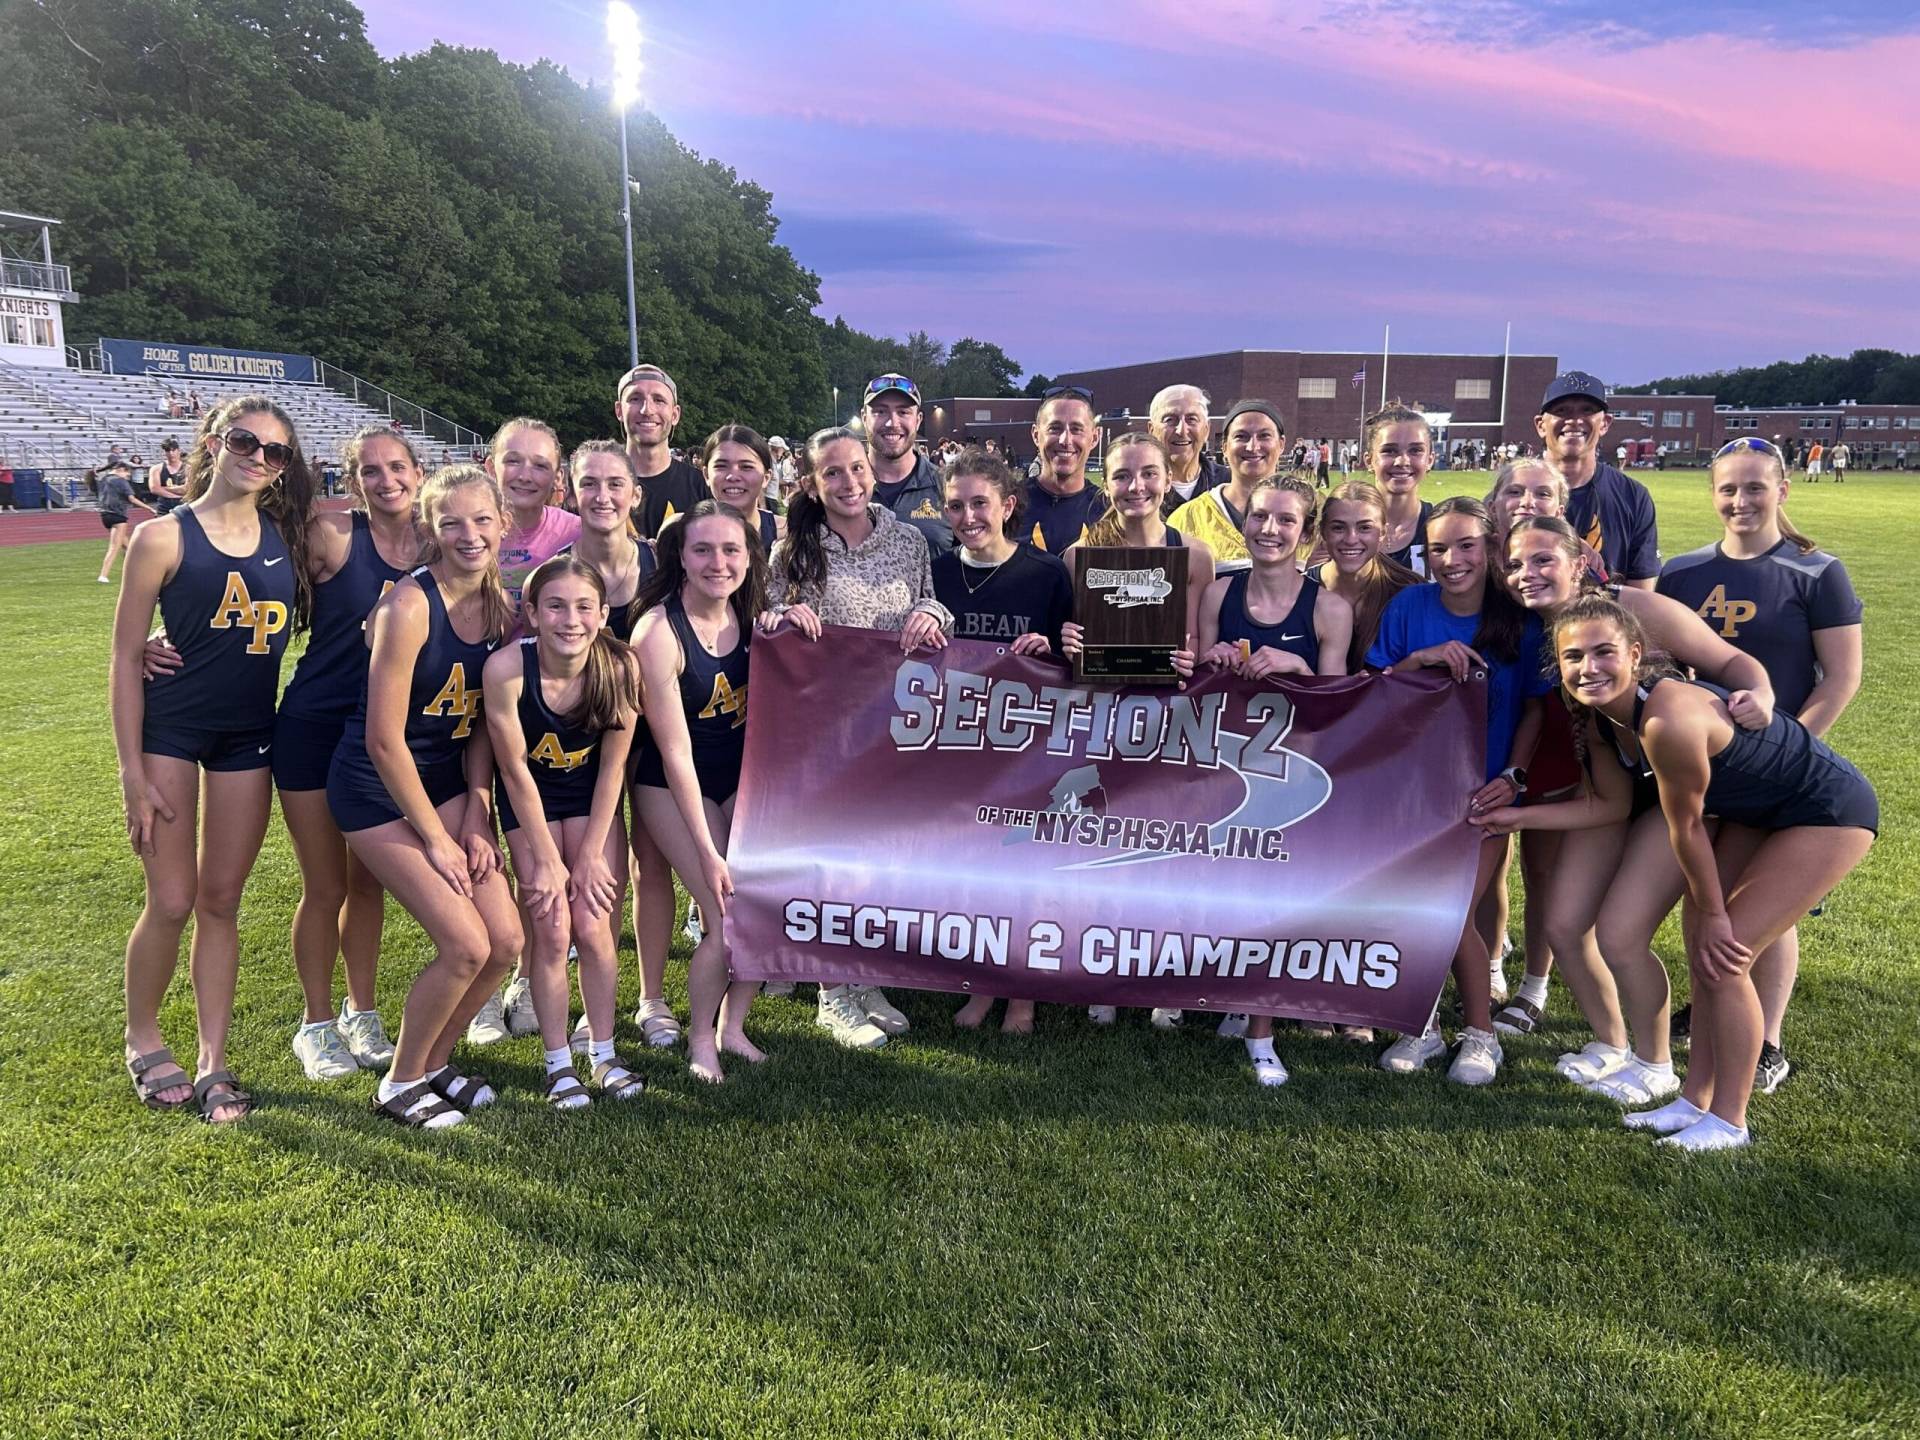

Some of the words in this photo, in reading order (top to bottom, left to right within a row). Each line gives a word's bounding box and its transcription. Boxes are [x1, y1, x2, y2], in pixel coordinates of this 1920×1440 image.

[142, 347, 180, 362] HOME
[158, 362, 170, 371] OF
[170, 363, 186, 372] THE
[188, 352, 235, 374] GOLDEN
[236, 356, 285, 378] KNIGHTS
[1086, 567, 1151, 588] SECTION
[1151, 567, 1165, 589] 2
[210, 571, 288, 655] AP
[1696, 584, 1758, 638] AP
[889, 659, 1228, 770] SECTION
[1238, 691, 1294, 782] 2
[976, 805, 998, 825] OF
[1003, 808, 1035, 828] THE
[1224, 826, 1290, 862] INC.
[783, 897, 1011, 967] SECTION
[1025, 920, 1065, 973] 2
[1079, 923, 1402, 991] CHAMPIONS
